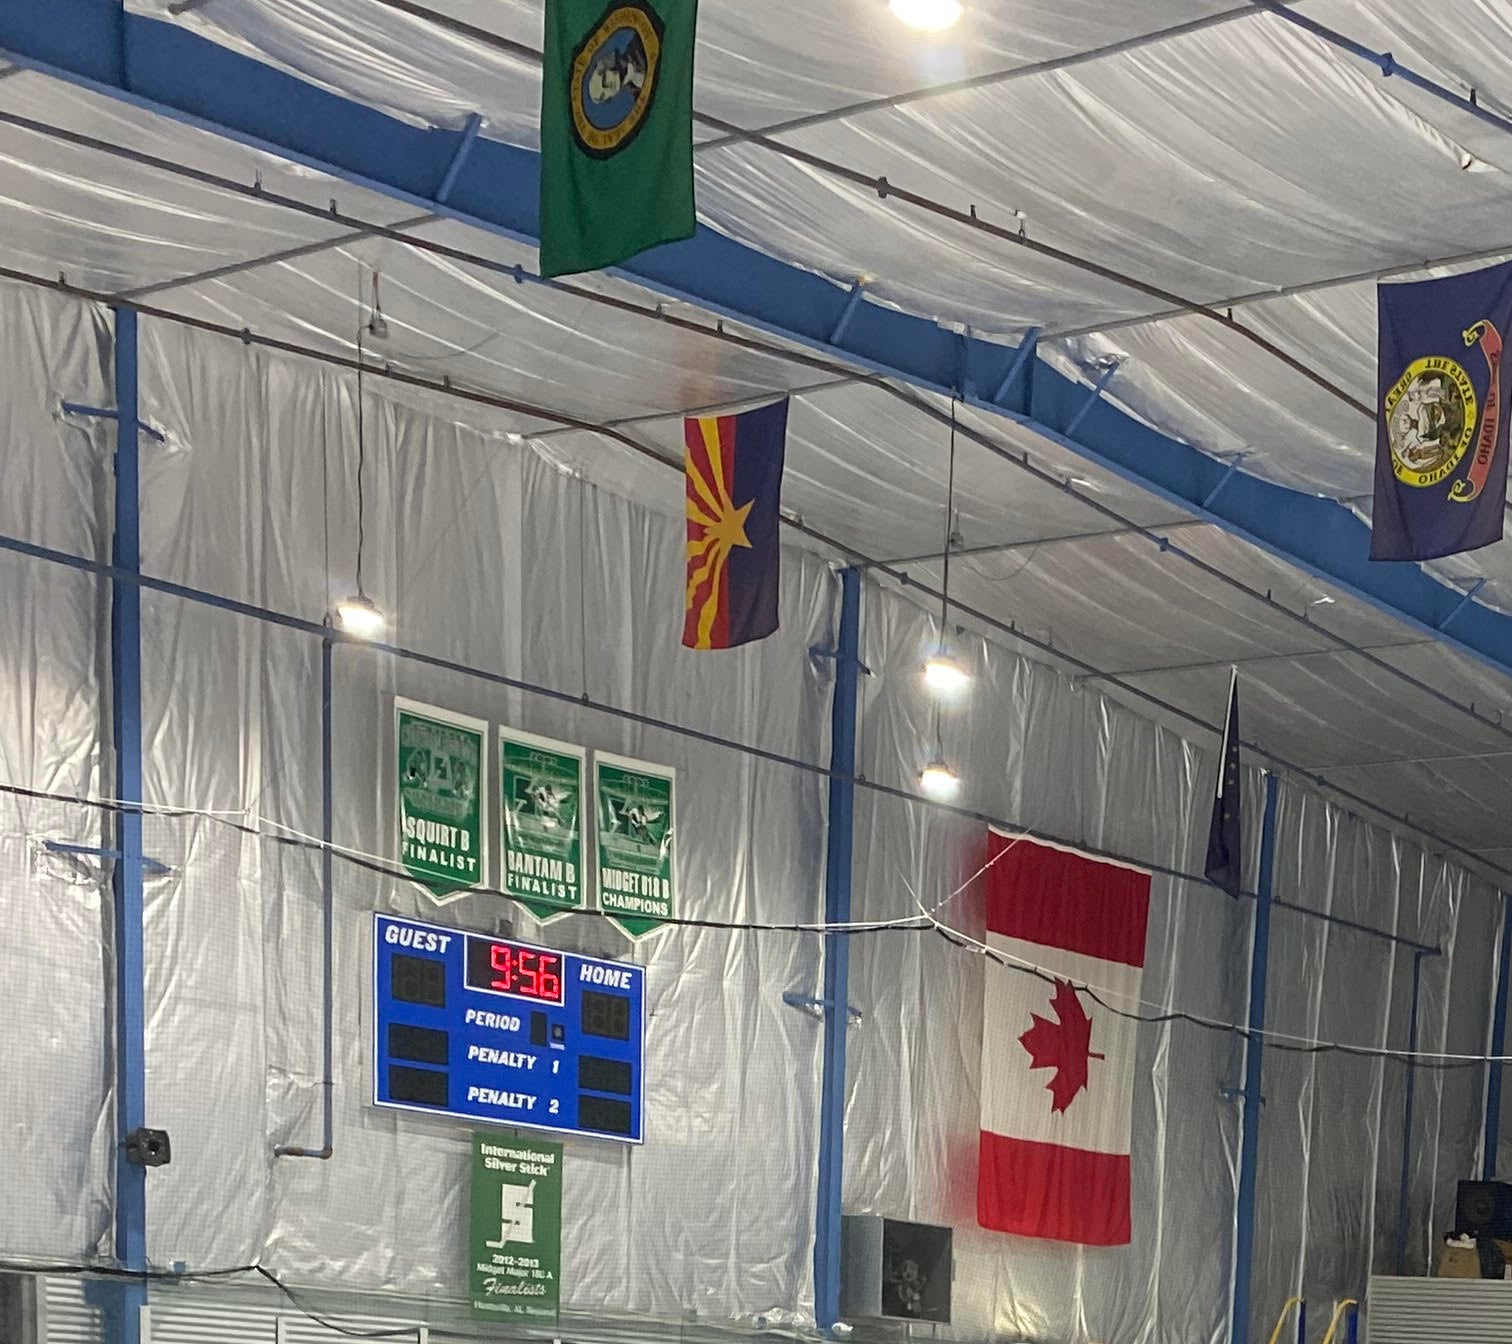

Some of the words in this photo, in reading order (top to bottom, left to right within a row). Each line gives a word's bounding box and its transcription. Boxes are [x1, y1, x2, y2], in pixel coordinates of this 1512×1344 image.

[407, 816, 459, 848] SQUIRT
[460, 829, 470, 852] B
[402, 840, 477, 872] FINALIST
[507, 849, 564, 882] BANTAM
[565, 861, 576, 883] B
[507, 873, 578, 900] FINALIST
[602, 867, 641, 893] MIDGET
[602, 893, 669, 917] CHAMPIONS
[385, 924, 452, 954] GUEST
[490, 944, 560, 999] 9:56
[579, 964, 632, 990] HOME
[465, 1008, 521, 1032] PERIOD
[467, 1045, 537, 1070] PENALTY
[552, 1060, 560, 1074] 1
[467, 1086, 537, 1110] PENALTY
[549, 1099, 560, 1114] 2
[480, 1142, 555, 1164] International
[484, 1157, 516, 1173] Silver
[519, 1161, 549, 1177] Stick
[482, 1276, 548, 1297] Finalists
